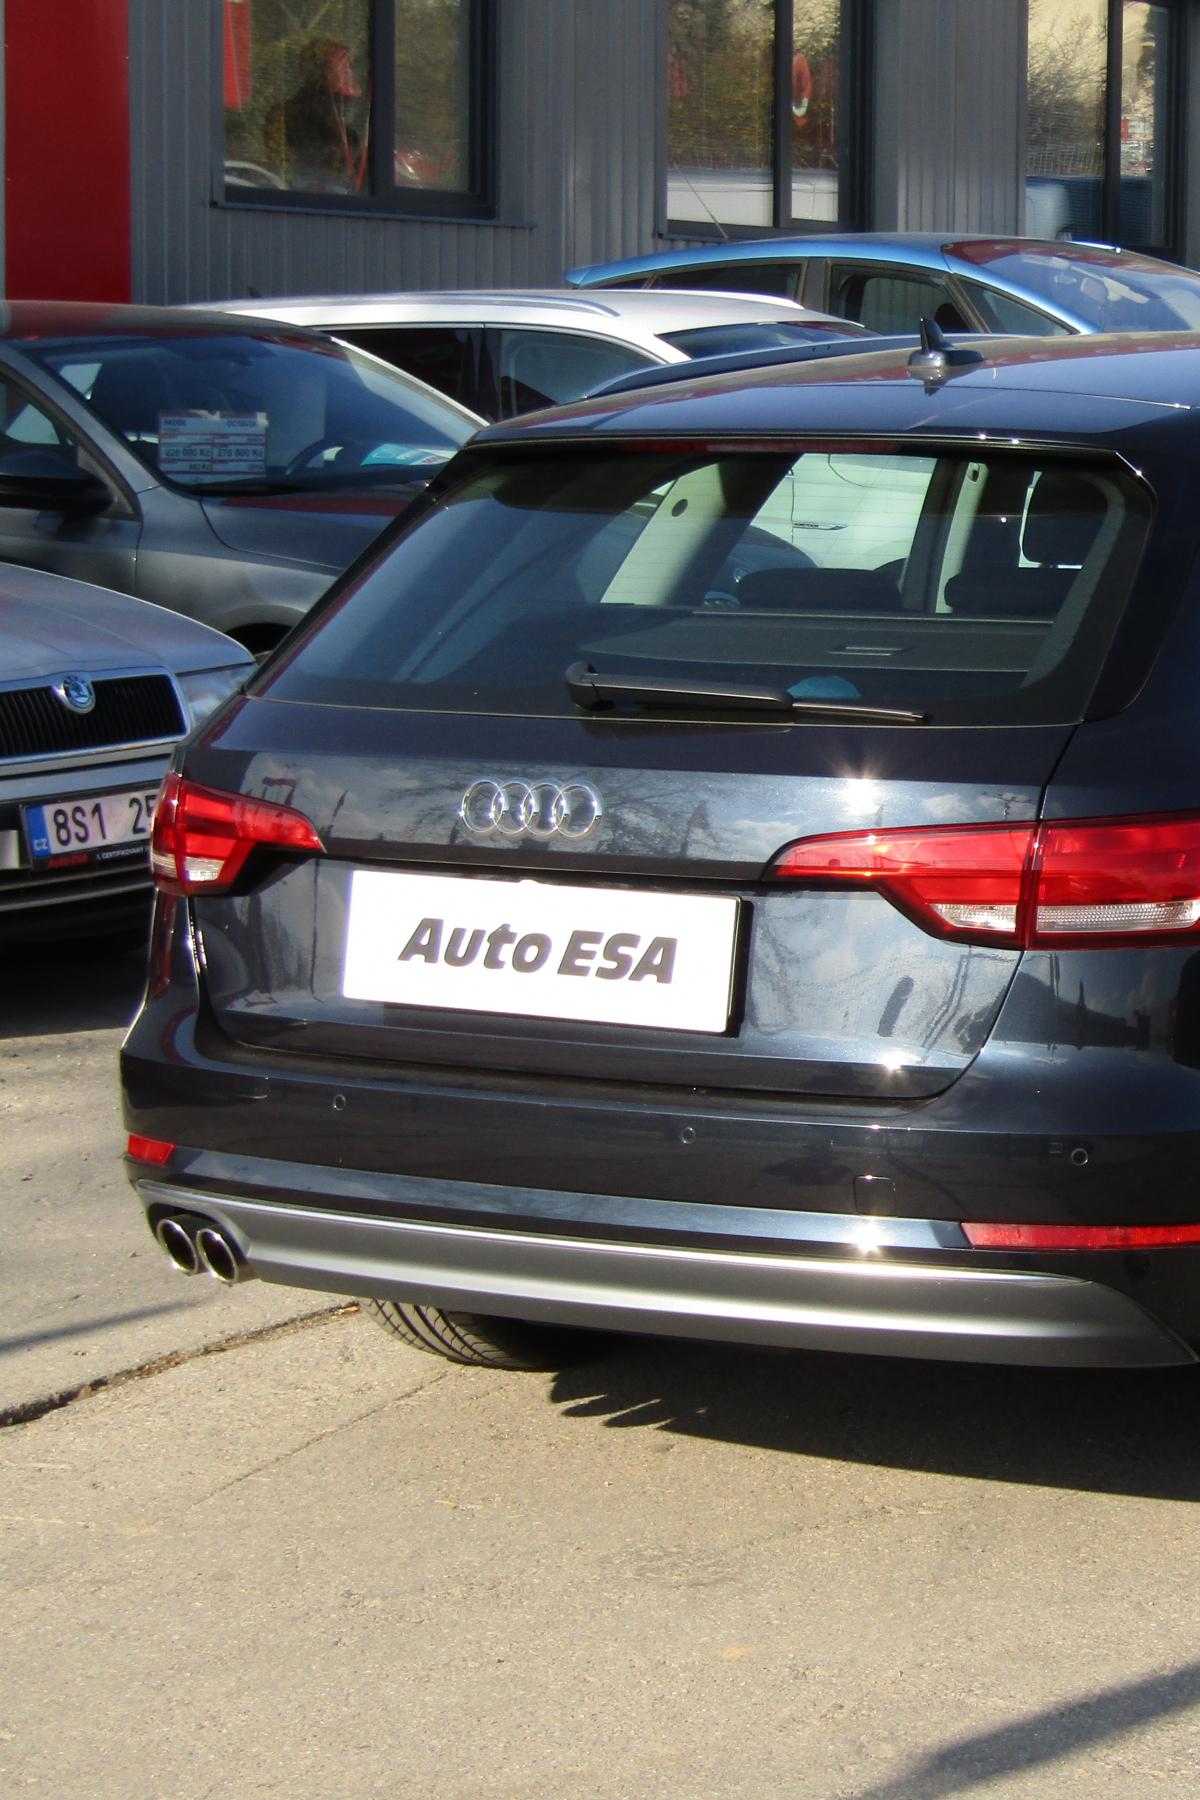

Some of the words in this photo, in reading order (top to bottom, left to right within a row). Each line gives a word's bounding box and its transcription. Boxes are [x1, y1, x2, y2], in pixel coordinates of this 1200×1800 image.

[33, 839, 48, 850] CZ
[53, 802, 107, 846] 8S1
[398, 917, 552, 973] Auto
[557, 929, 677, 984] ESA
